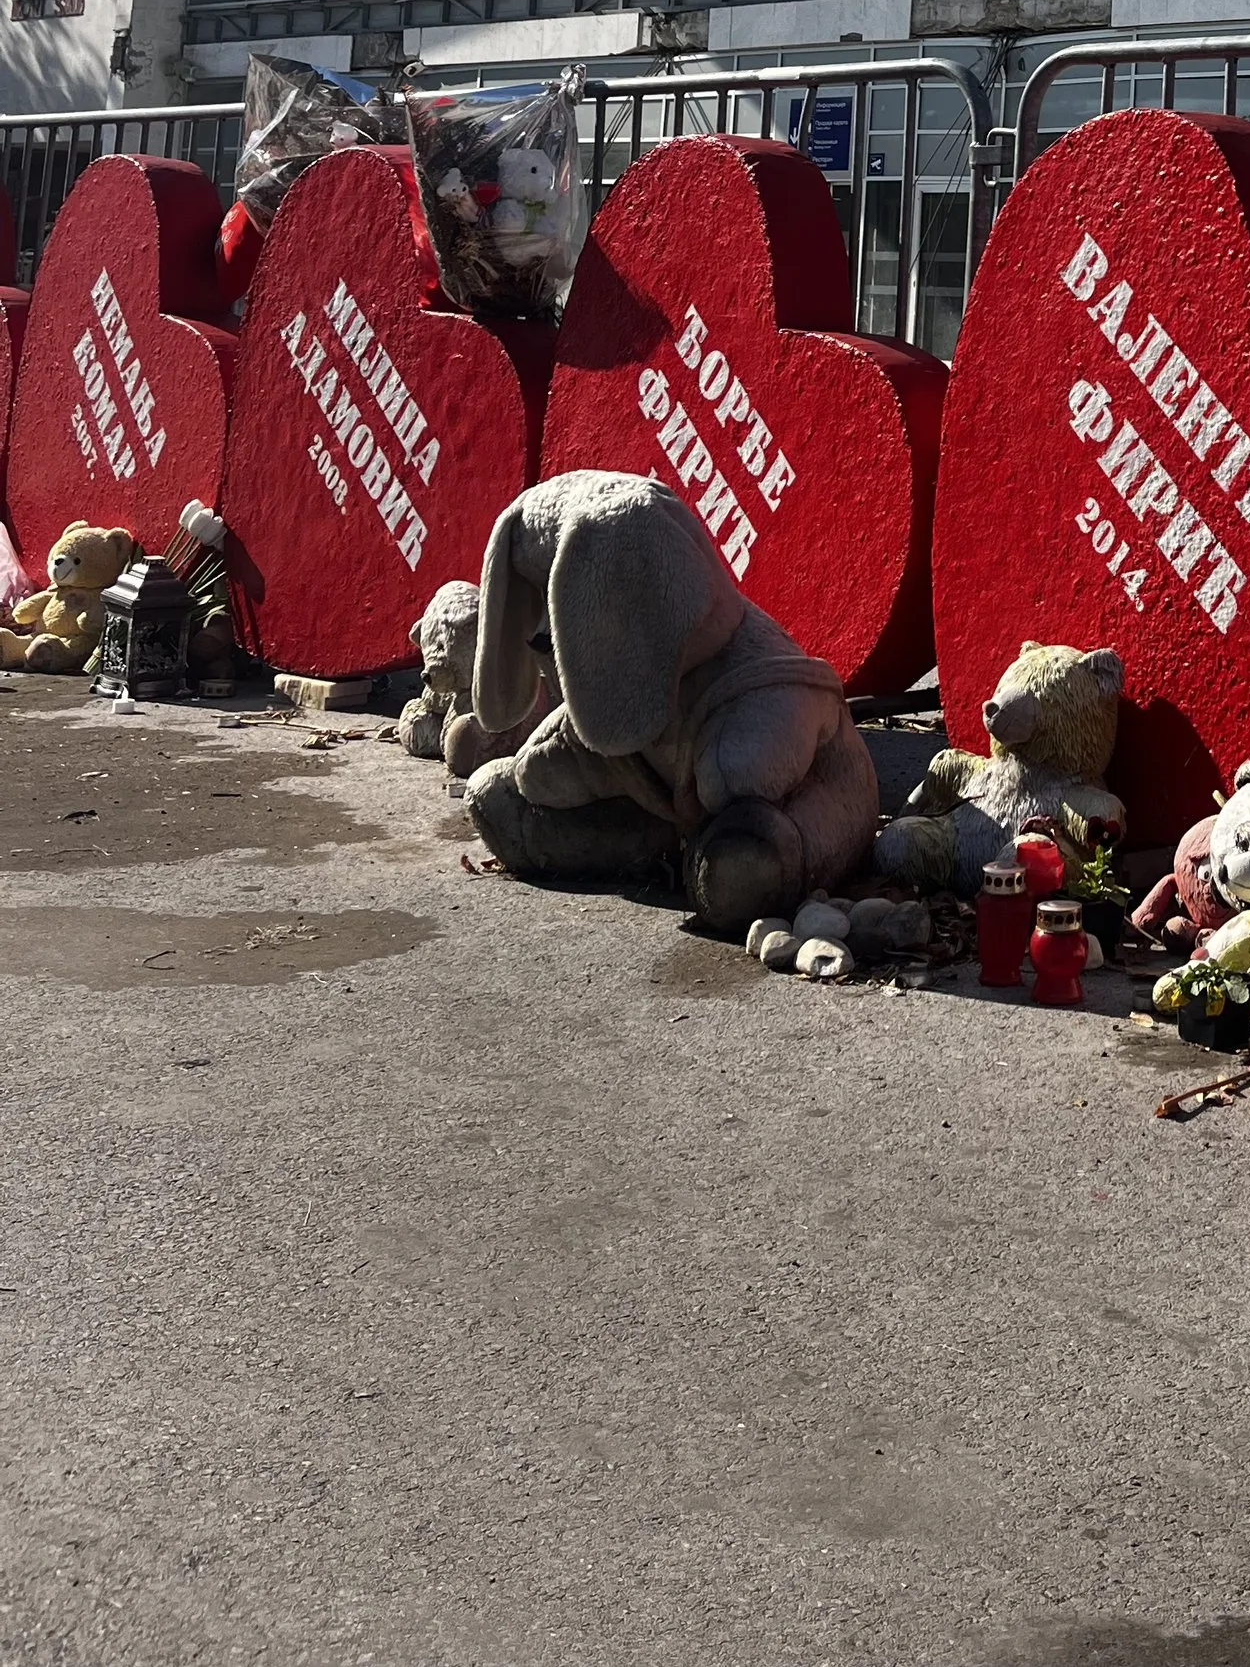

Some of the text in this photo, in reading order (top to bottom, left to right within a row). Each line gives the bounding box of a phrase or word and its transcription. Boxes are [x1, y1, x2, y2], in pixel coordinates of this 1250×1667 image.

[71, 403, 98, 480] 2007.
[72, 327, 136, 481] КОМАР
[90, 266, 167, 468] НЕМАЊА
[280, 310, 429, 572] АДАМОВИЋ
[322, 276, 441, 486] МИЛИЦА
[674, 303, 797, 513] ЂОРЂЕ
[307, 434, 348, 515] 2008.
[637, 367, 758, 582] ФИРИЋ
[1067, 378, 1248, 635] ФИРИЋ
[1074, 496, 1149, 613] 2014.
